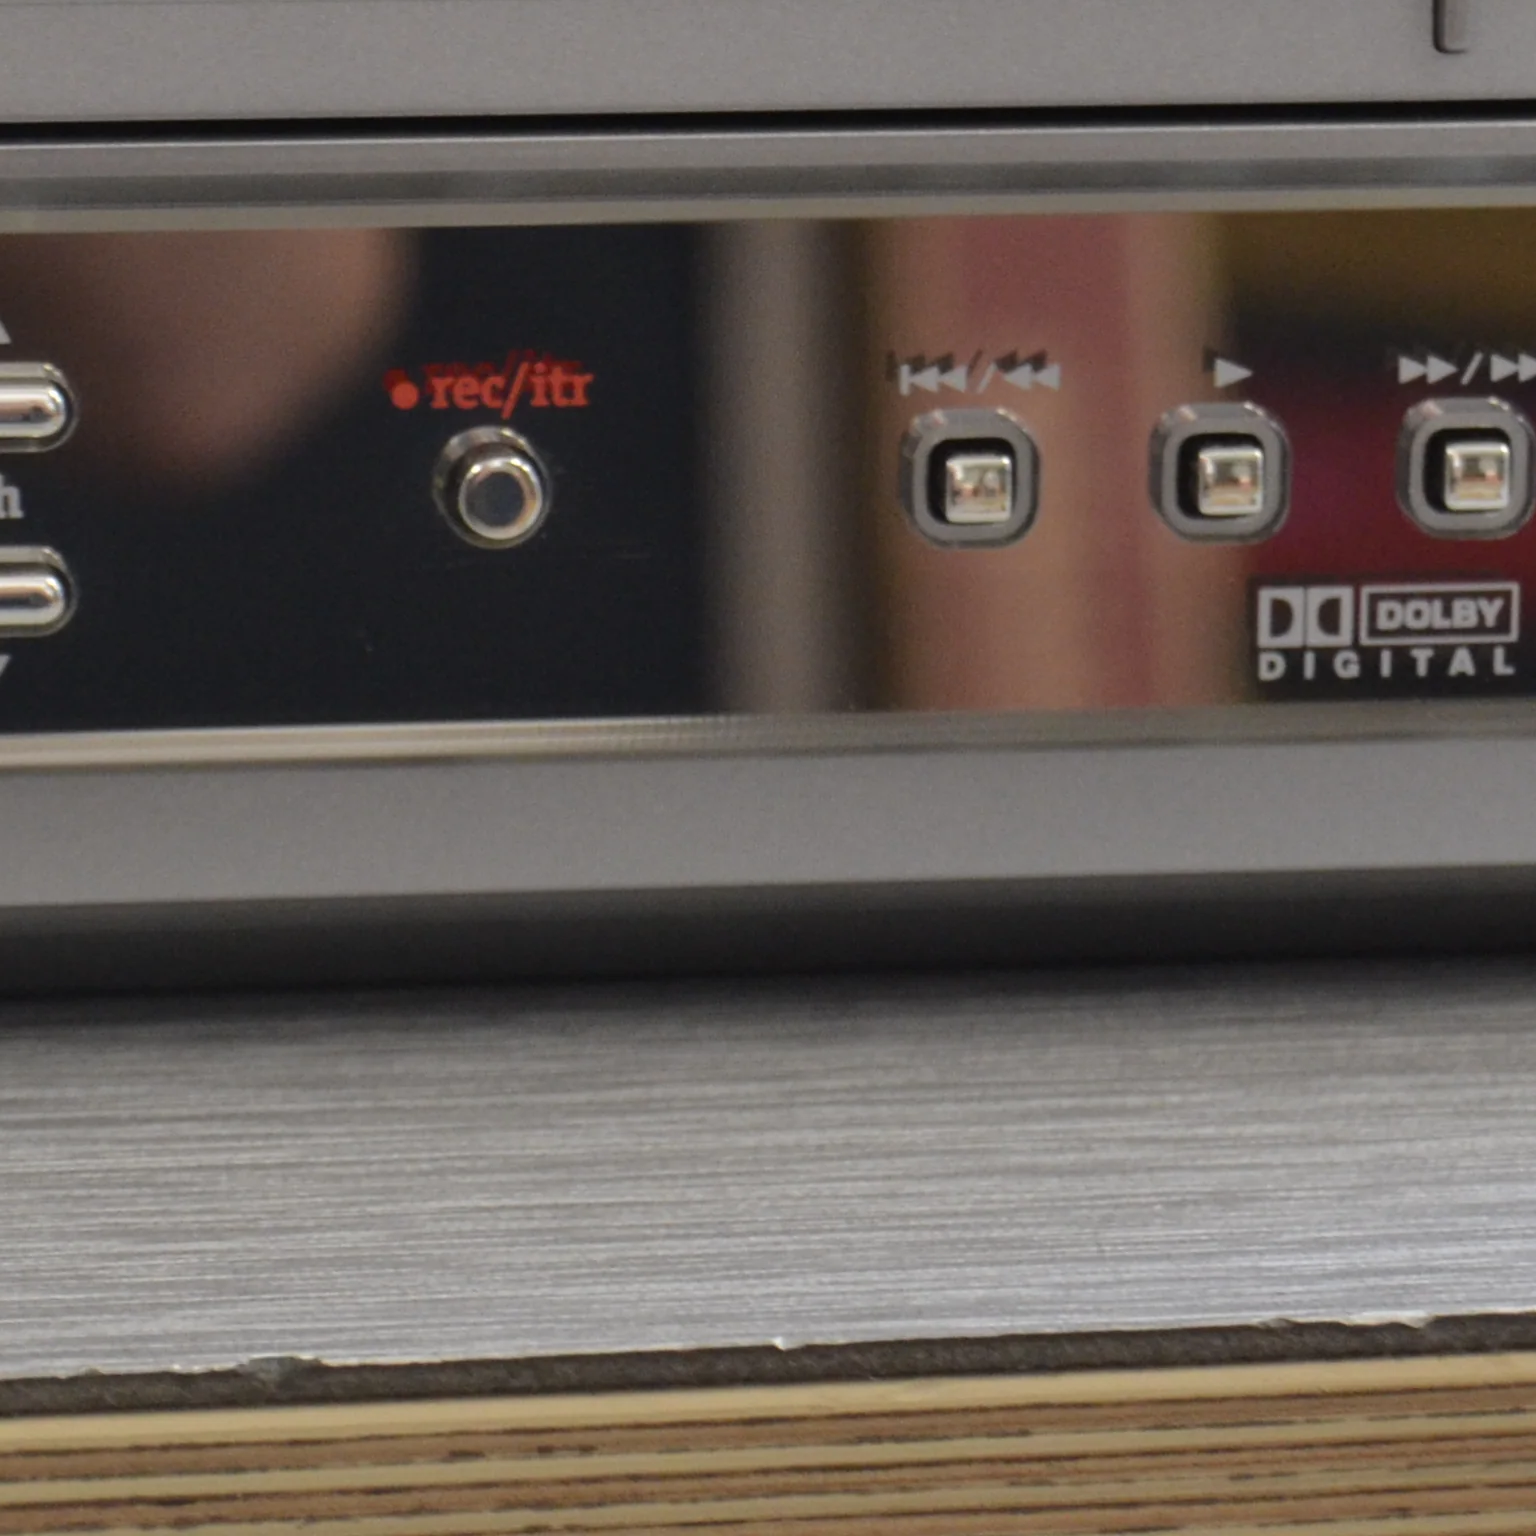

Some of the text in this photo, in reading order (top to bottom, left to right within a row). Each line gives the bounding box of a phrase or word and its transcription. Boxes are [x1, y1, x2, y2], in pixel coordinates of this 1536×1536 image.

[429, 361, 595, 420] rec/itr
[1376, 597, 1504, 631] DOLBY
[1257, 646, 1516, 681] DIGITAL
